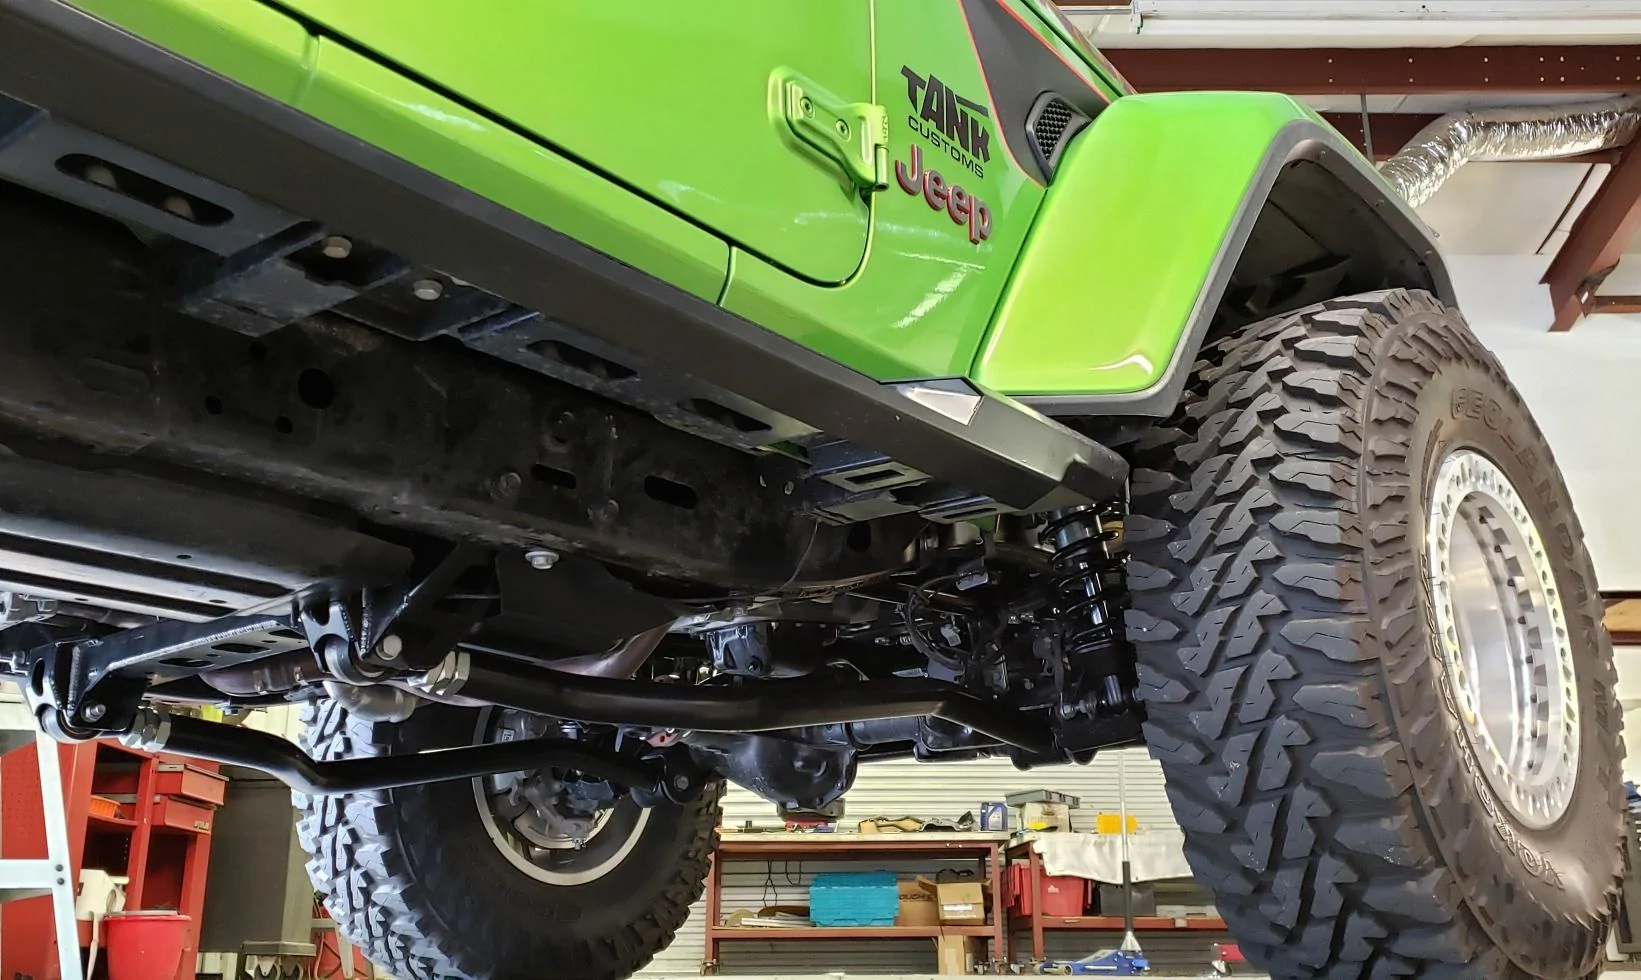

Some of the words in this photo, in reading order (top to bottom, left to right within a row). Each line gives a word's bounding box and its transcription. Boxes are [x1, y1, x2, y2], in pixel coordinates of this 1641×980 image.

[901, 65, 991, 163] TANK
[908, 115, 984, 179] CUSTOMS
[895, 144, 992, 245] Jeep
